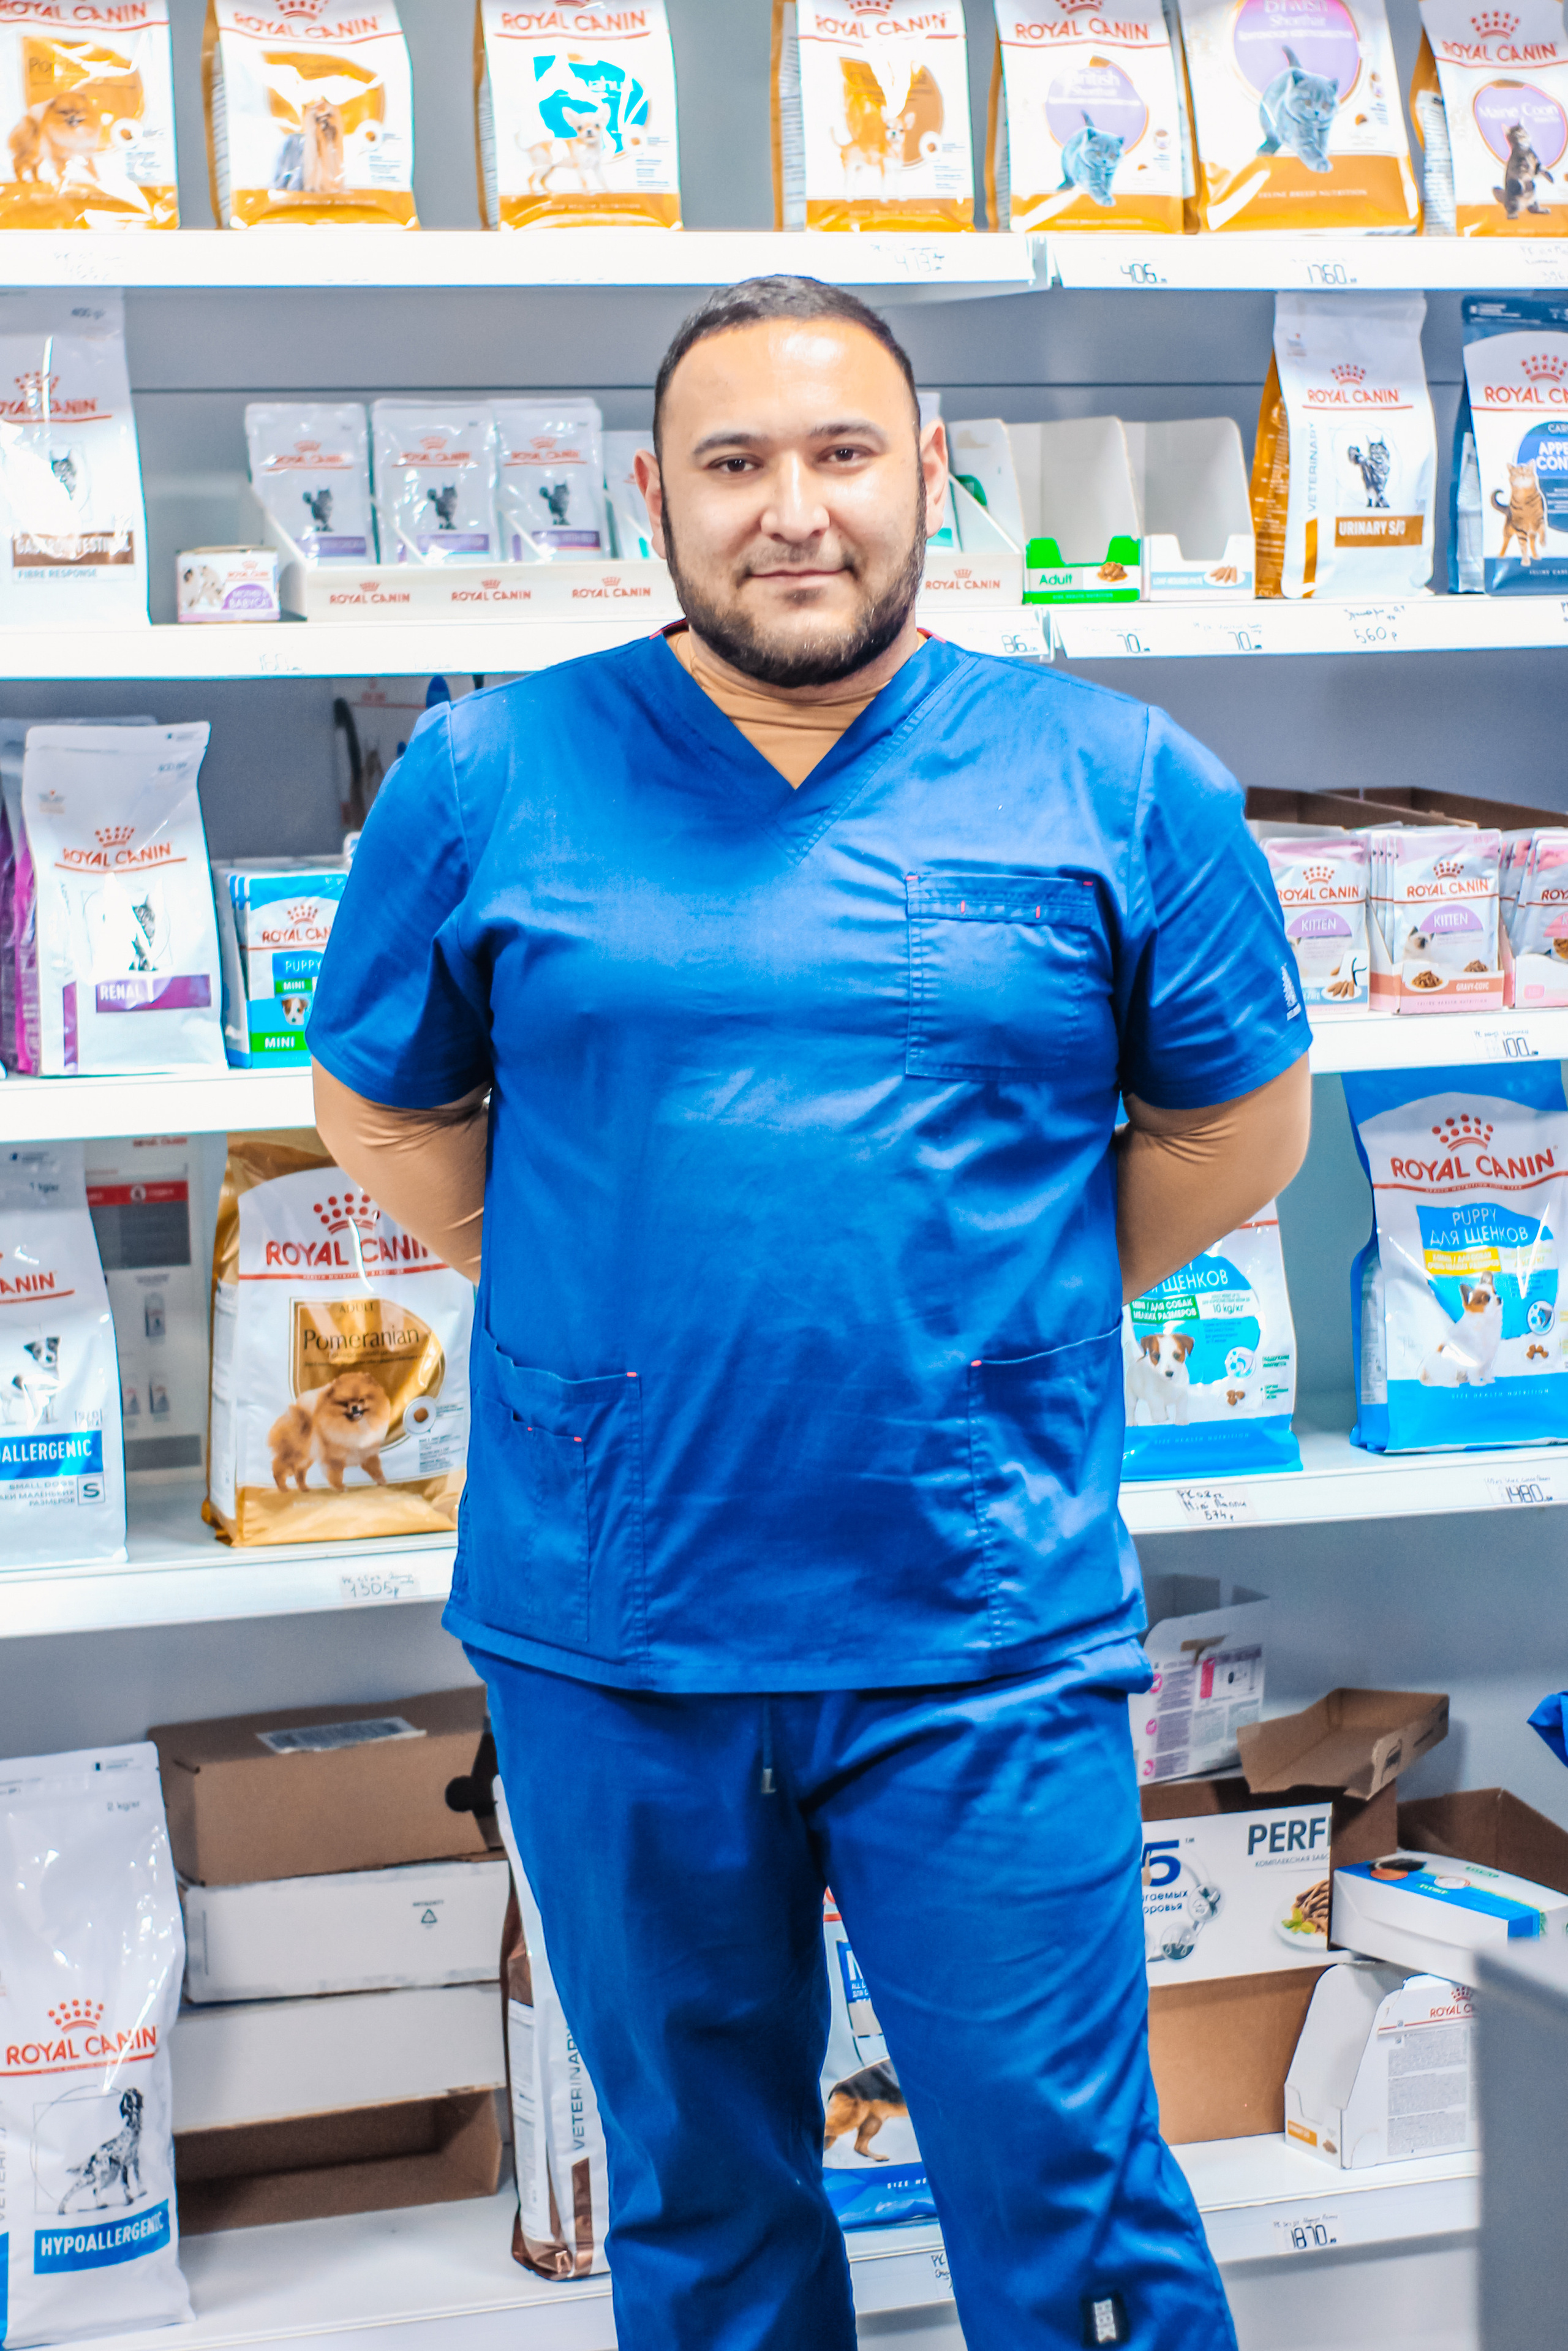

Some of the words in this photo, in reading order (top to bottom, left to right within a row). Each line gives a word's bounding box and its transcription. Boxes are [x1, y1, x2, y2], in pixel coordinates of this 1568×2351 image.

[73, 2, 146, 23] CANIN
[502, 12, 570, 31] ROYAL
[574, 12, 646, 31] CANIN
[233, 12, 301, 37] ROYAL
[305, 16, 379, 38] CANIN
[815, 15, 871, 39] ROYAL
[876, 12, 946, 35] CANIN
[1015, 21, 1082, 39] ROYAL
[1088, 18, 1150, 40] CANIN
[1442, 40, 1492, 61] ROYAL
[1497, 43, 1556, 61] CANIN
[1308, 389, 1349, 404] ROYAL
[1354, 388, 1399, 403] CANIN
[1485, 387, 1545, 404] ROYAL
[1308, 423, 1318, 513] VETERINARY
[1339, 521, 1387, 535] URINARY
[925, 580, 961, 590] ROYAL
[965, 579, 1001, 589] CANIN
[1039, 573, 1072, 585] Adult
[330, 594, 368, 605] ROYAL
[371, 593, 410, 603] CANIN
[451, 591, 489, 602] ROYAL
[492, 590, 531, 600] CANIN
[572, 589, 608, 599] ROYAL
[613, 587, 651, 597] CANIN
[1354, 626, 1387, 644] 560
[1001, 635, 1028, 654] 86
[62, 847, 111, 867] ROYAL
[115, 842, 172, 866] CANIN
[1277, 887, 1316, 902] ROYAL
[1319, 885, 1360, 899] CANIN
[1407, 884, 1446, 898] ROYAL
[1449, 877, 1490, 894] CANIN
[1302, 918, 1336, 932] KITTEN
[1434, 912, 1468, 927] KITTEN
[262, 927, 301, 943] ROYAL
[306, 926, 331, 939] CAN
[285, 959, 322, 973] PUPPY
[100, 983, 143, 1001] RENAL
[284, 981, 305, 991] MINI
[265, 1037, 295, 1049] MINI
[1390, 1156, 1470, 1182] ROYAL
[1475, 1148, 1555, 1179] CANIN
[1452, 1207, 1497, 1226] PUPPY
[1430, 1229, 1460, 1246] ДЛЯ
[1464, 1225, 1529, 1245] ЩЕНКОВ
[266, 1240, 349, 1266] ROYAL
[1162, 1269, 1228, 1293] ЩЕНКОВ
[339, 1302, 374, 1313] ADULT
[1151, 1302, 1165, 1312] ДЛЯ
[1166, 1298, 1193, 1310] СОБАК
[1213, 1304, 1221, 1313] 10
[1158, 1308, 1197, 1321] РАЗМЕРОВ
[304, 1325, 419, 1350] Pomeranian
[2, 1439, 92, 1463] ALLERGENIC
[83, 1482, 100, 1498] S
[1506, 1483, 1544, 1503] 1480
[1256, 1855, 1310, 1868] КОМПЛЕКСНАЯ
[1430, 2006, 1461, 2018] ROYAL
[6, 2038, 81, 2066] ROYAL
[85, 2025, 157, 2056] CANIN
[41, 2211, 164, 2257] HYPOALLERGENIC
[1291, 2224, 1327, 2249] 1870
